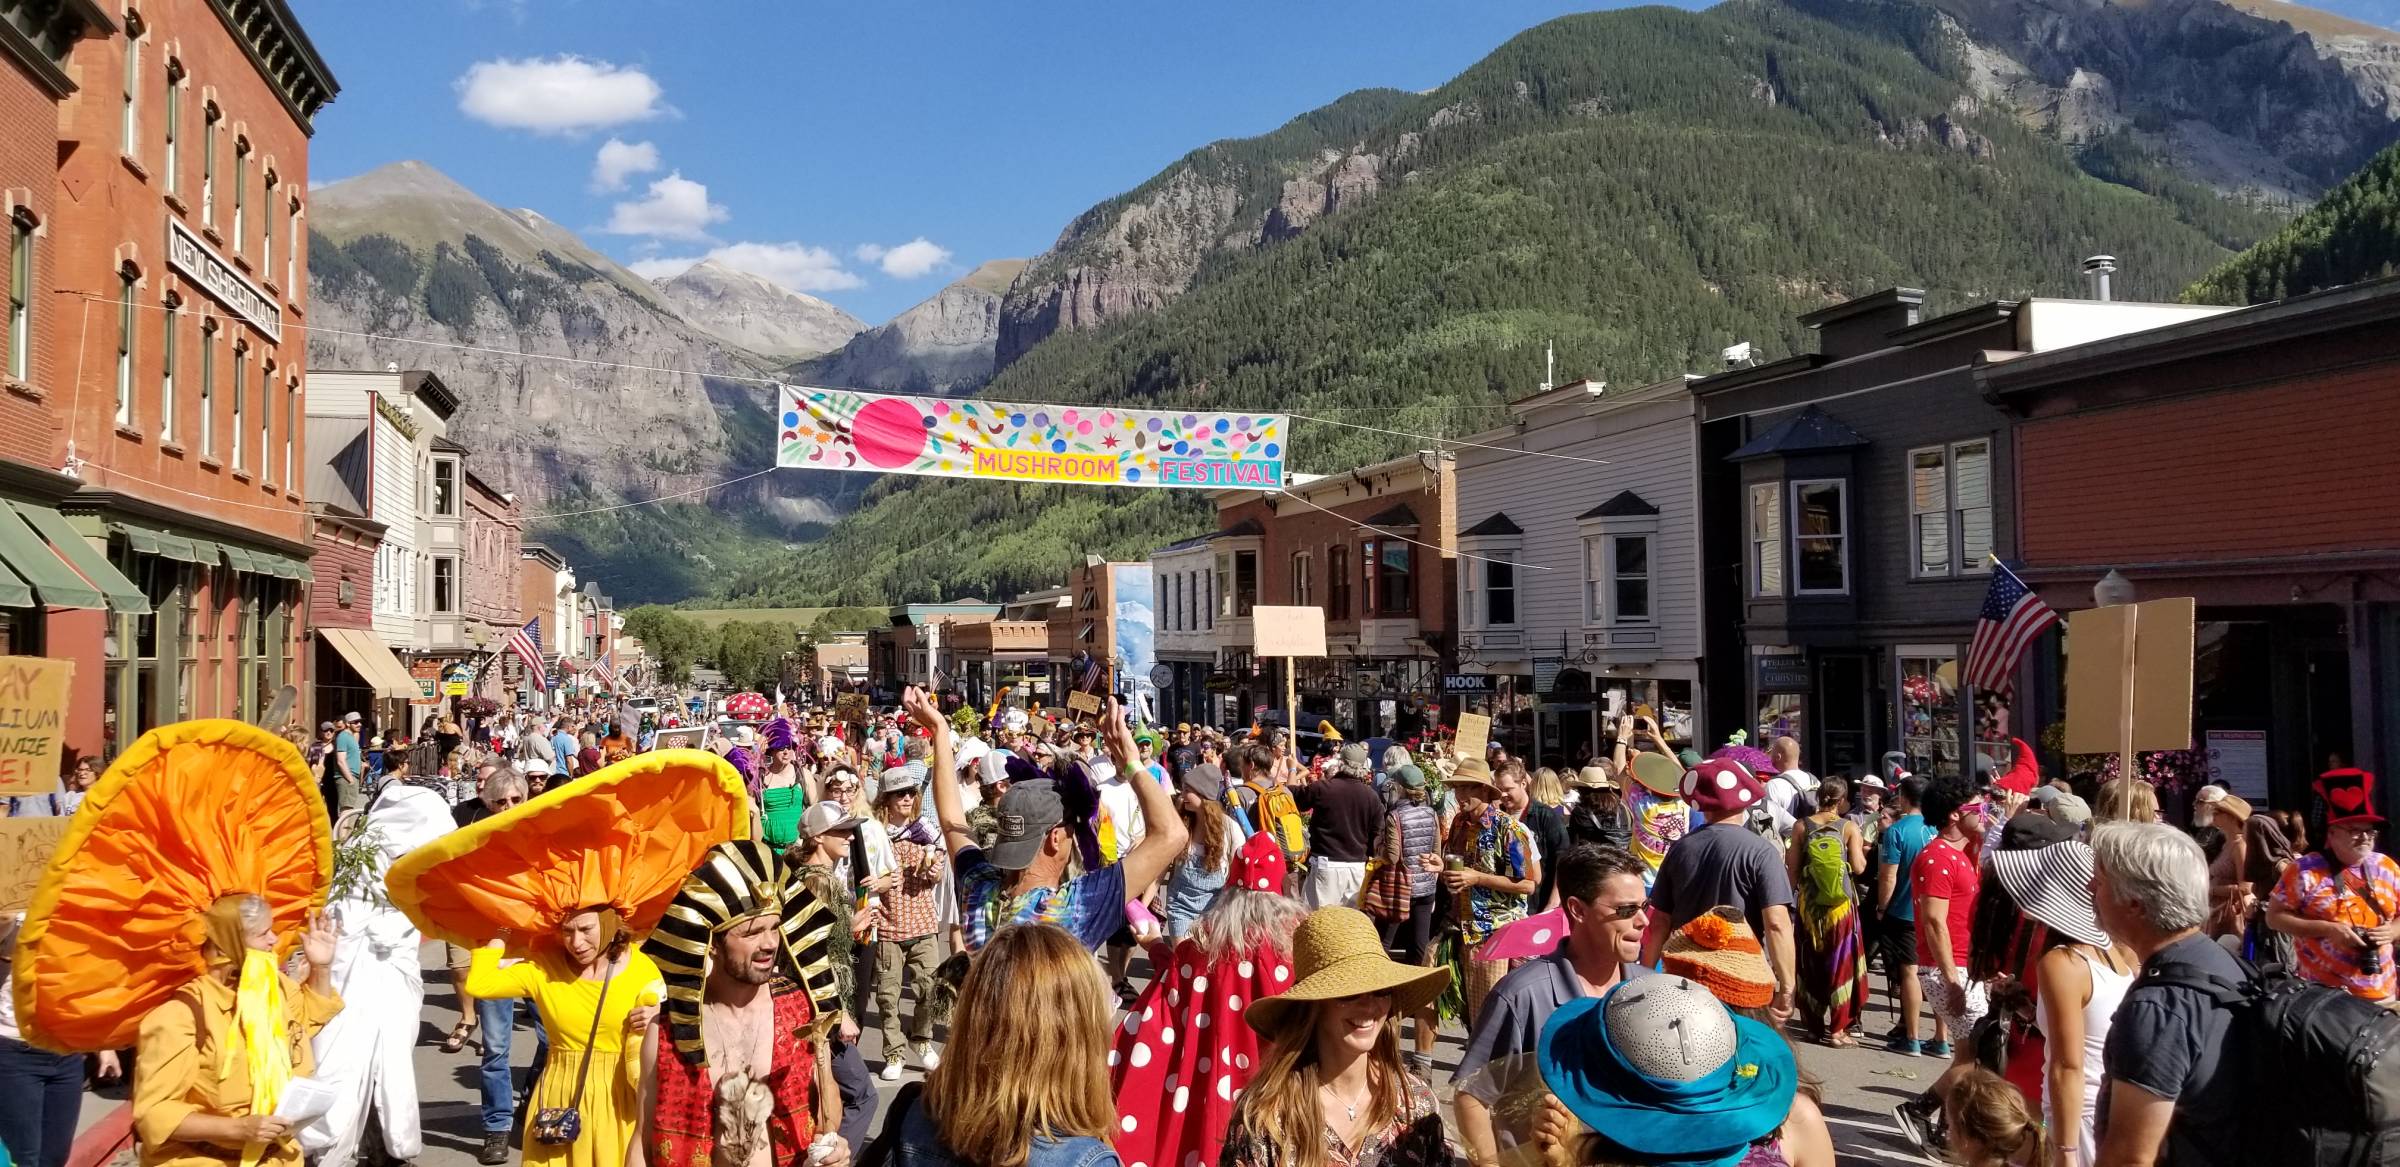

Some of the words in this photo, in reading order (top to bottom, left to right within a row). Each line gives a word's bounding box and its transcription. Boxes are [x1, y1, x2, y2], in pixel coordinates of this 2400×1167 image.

[173, 229, 206, 279] NEW
[208, 259, 276, 334] SHERIDAN
[978, 452, 1116, 479] MUSHROOM
[1162, 461, 1278, 485] FESTIVAL
[1445, 676, 1486, 689] HOOK
[0, 737, 51, 757] NIZE
